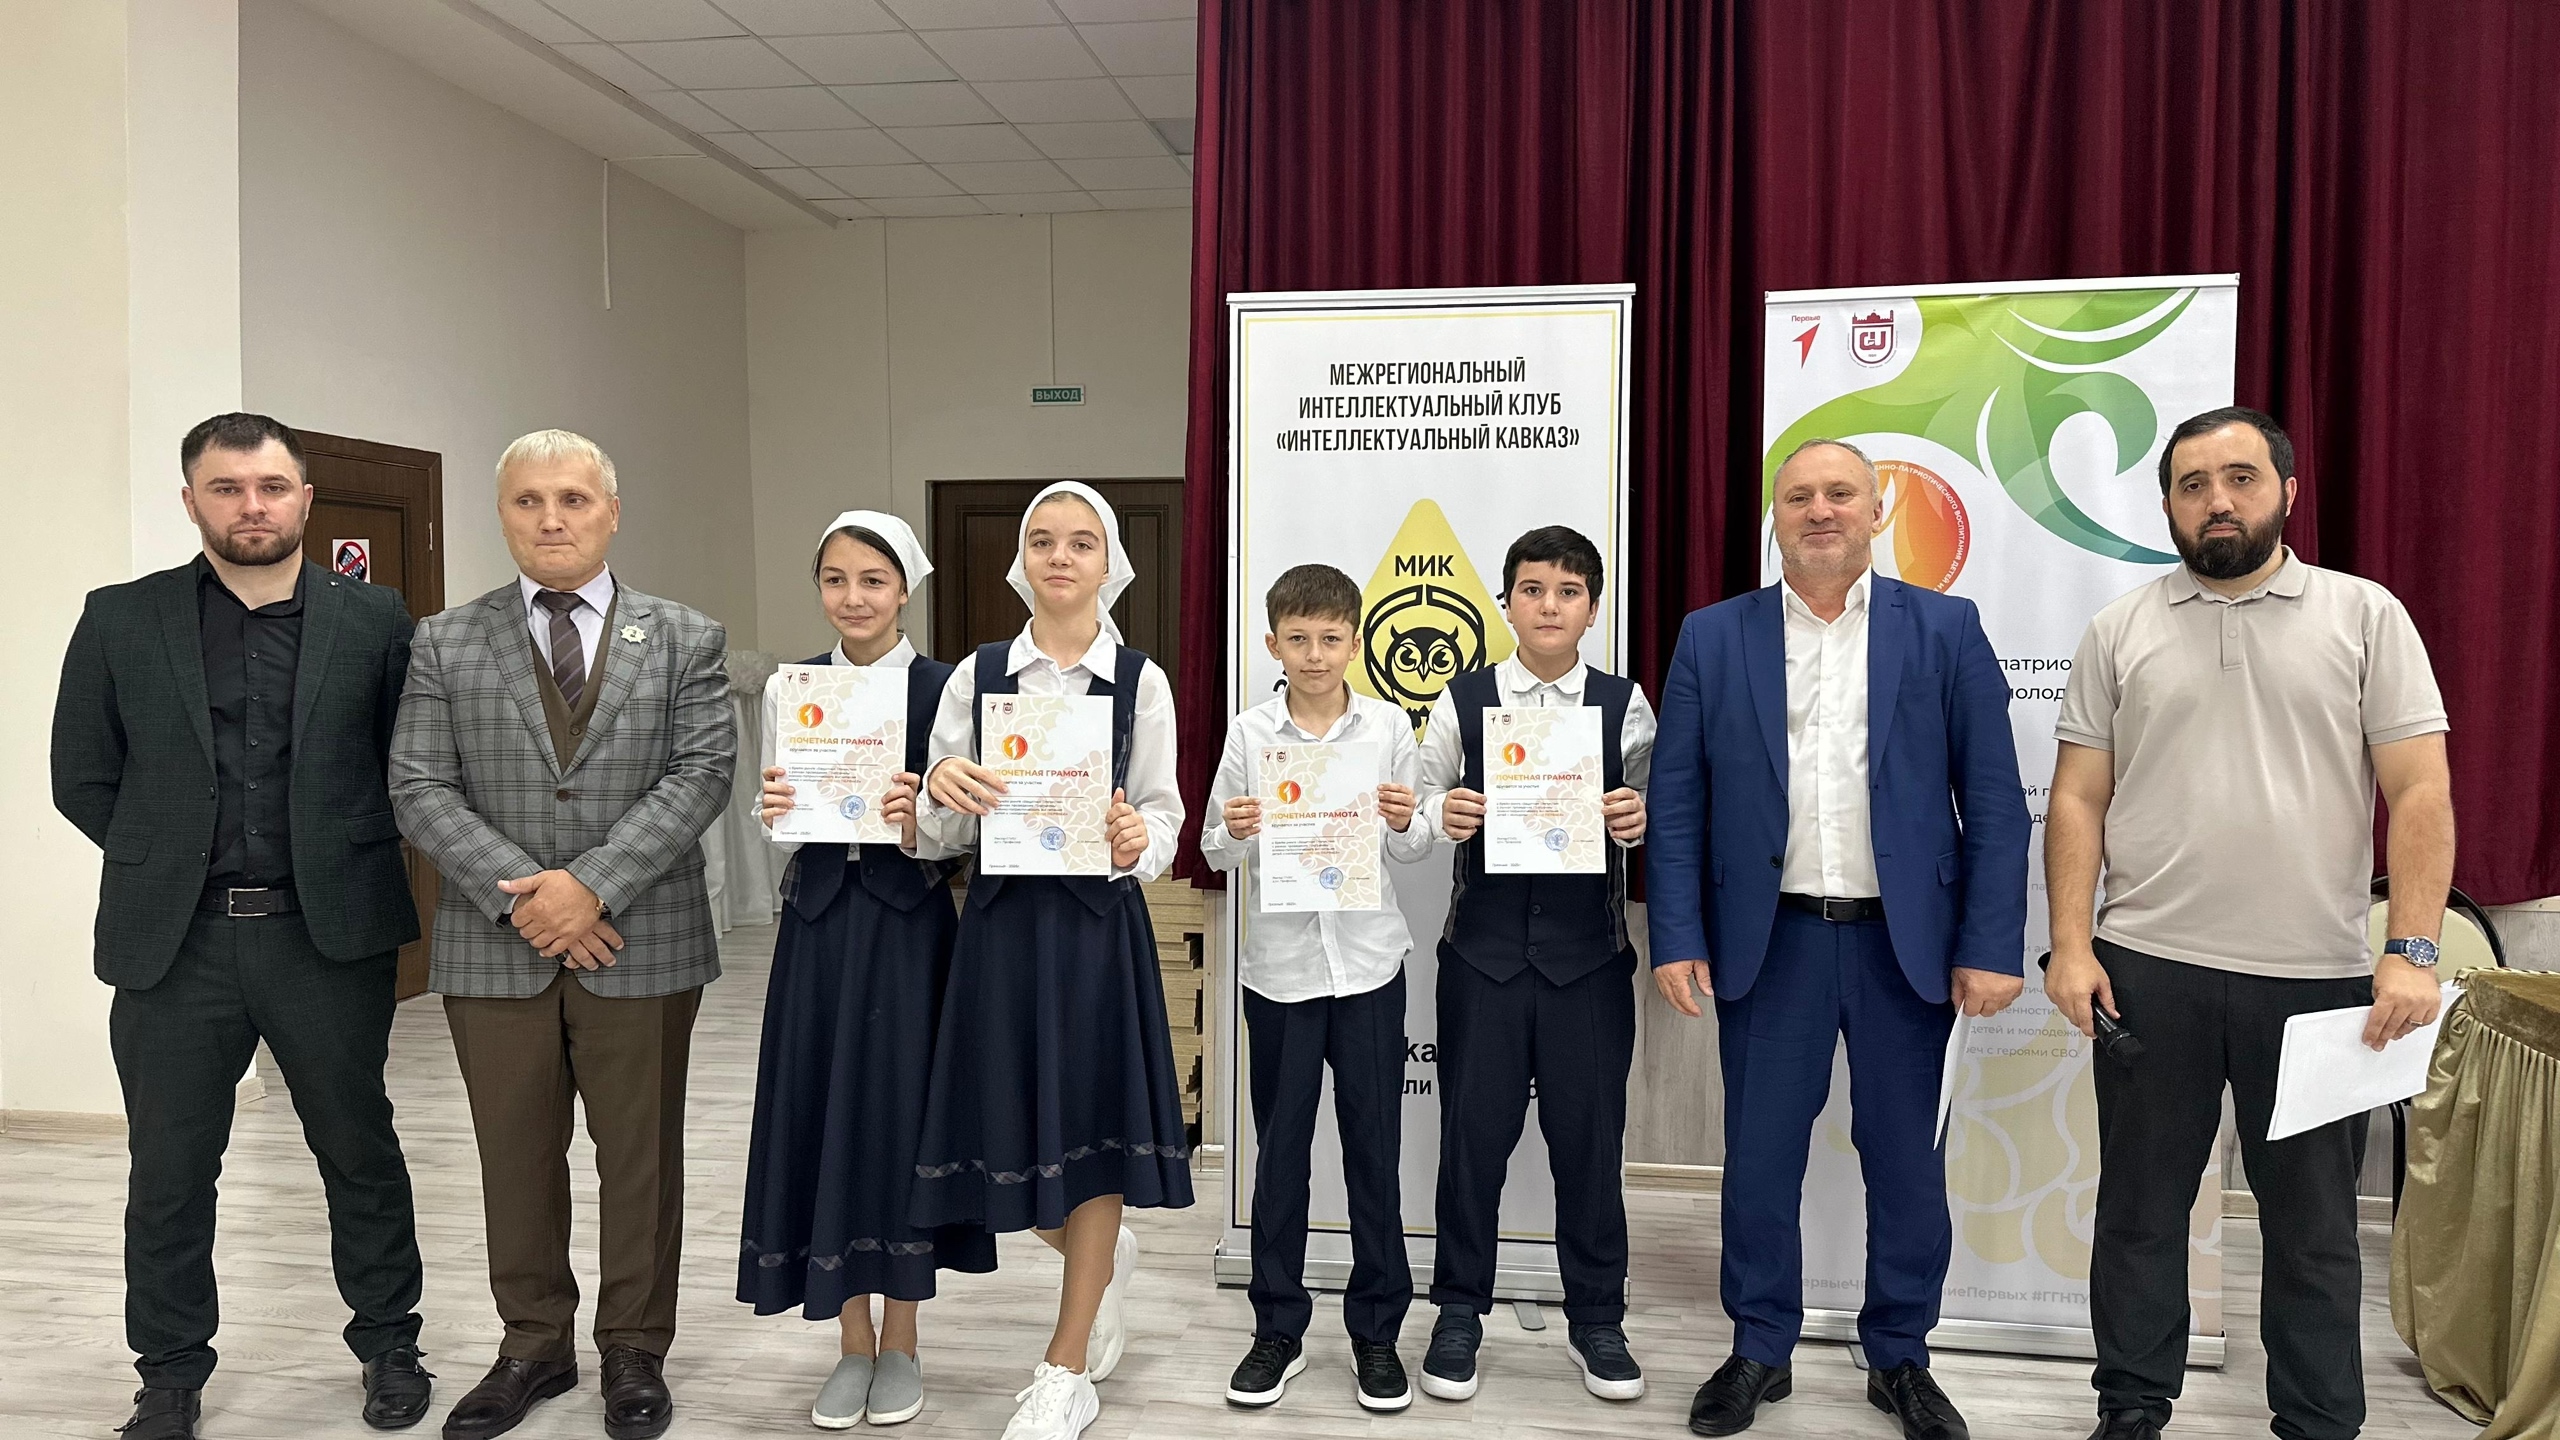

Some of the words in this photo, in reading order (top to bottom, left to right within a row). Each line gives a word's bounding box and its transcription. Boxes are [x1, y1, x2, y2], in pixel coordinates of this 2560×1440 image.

[1791, 315, 1821, 323] Первые
[1329, 356, 1526, 386] МЕЖРЕГИОНАЛЬНЫЙ
[1035, 390, 1079, 401] ВЫХОД
[1299, 390, 1503, 419] ИНТЕЛЛЕКТУАЛЬНЫЙ
[1508, 393, 1562, 416] КЛУБ
[1276, 423, 1490, 451] «ИНТЕЛЛЕКТУАЛЬНЫЙ
[1496, 425, 1580, 449] КАВКАЗ»
[1954, 510, 1965, 561] ВОСПИТАНИЯ
[1395, 555, 1455, 577] МИК
[1942, 560, 1959, 584] ДЕТЕЙ
[1998, 658, 2073, 675] патрио
[789, 736, 839, 745] ПОЧЕТНАЯ
[841, 737, 884, 746] ГРАМОТА
[994, 769, 1044, 778] ПОЧЕТНАЯ
[1046, 769, 1090, 778] ГРАМОТА
[1271, 811, 1317, 820] ПОЧЕТНАЯ
[1318, 810, 1359, 819] ГРАМОТА
[2007, 1027, 2015, 1035] и
[2019, 1028, 2081, 1038] молодежи
[1986, 1047, 1994, 1055] с
[1996, 1047, 2048, 1058] героями
